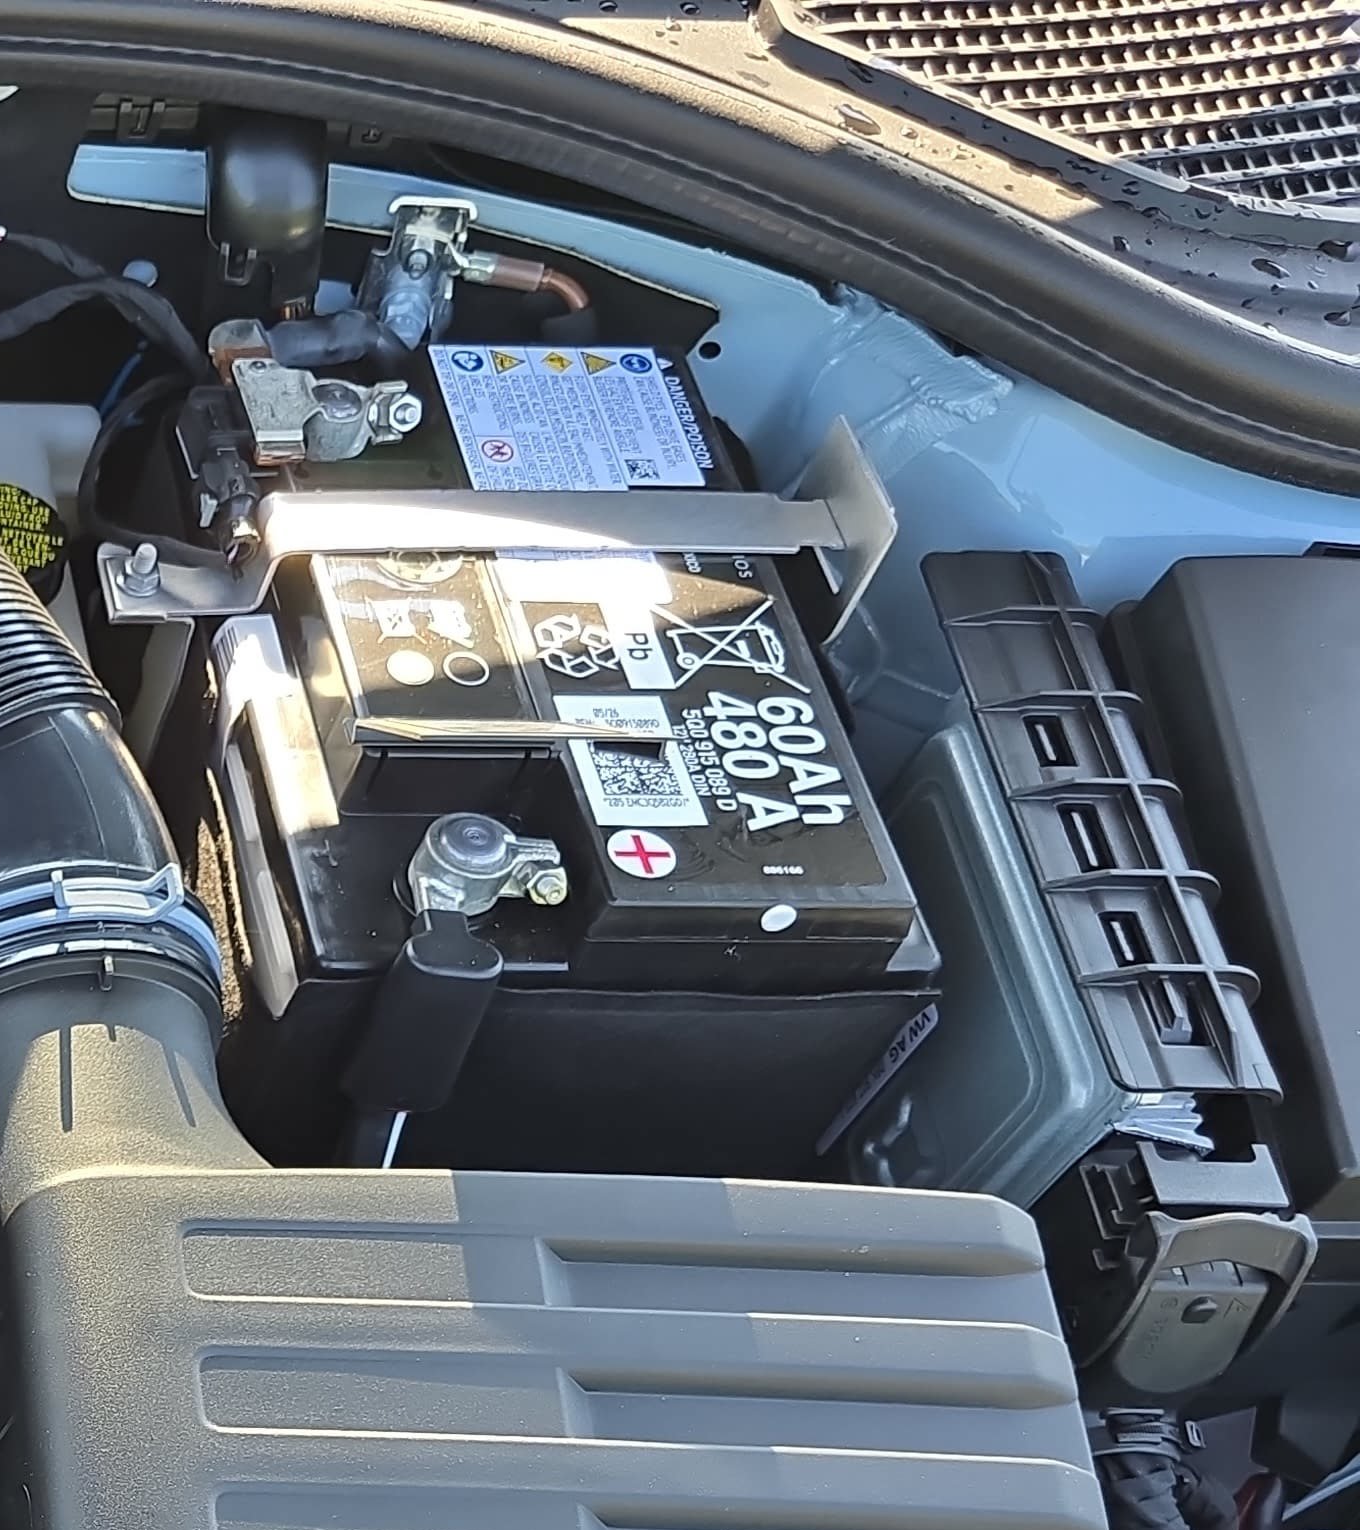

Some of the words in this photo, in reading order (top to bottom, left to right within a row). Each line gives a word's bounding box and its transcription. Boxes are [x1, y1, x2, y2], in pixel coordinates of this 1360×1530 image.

[663, 376, 714, 469] DANGER/POISON
[626, 632, 653, 661] Pb
[703, 691, 781, 780] 480
[694, 740, 720, 766] 915
[756, 696, 853, 825] 60Ah
[708, 768, 732, 797] 089
[716, 799, 738, 812] D
[736, 791, 801, 832] A
[908, 1011, 930, 1042] VW
[888, 1042, 910, 1064] AG
